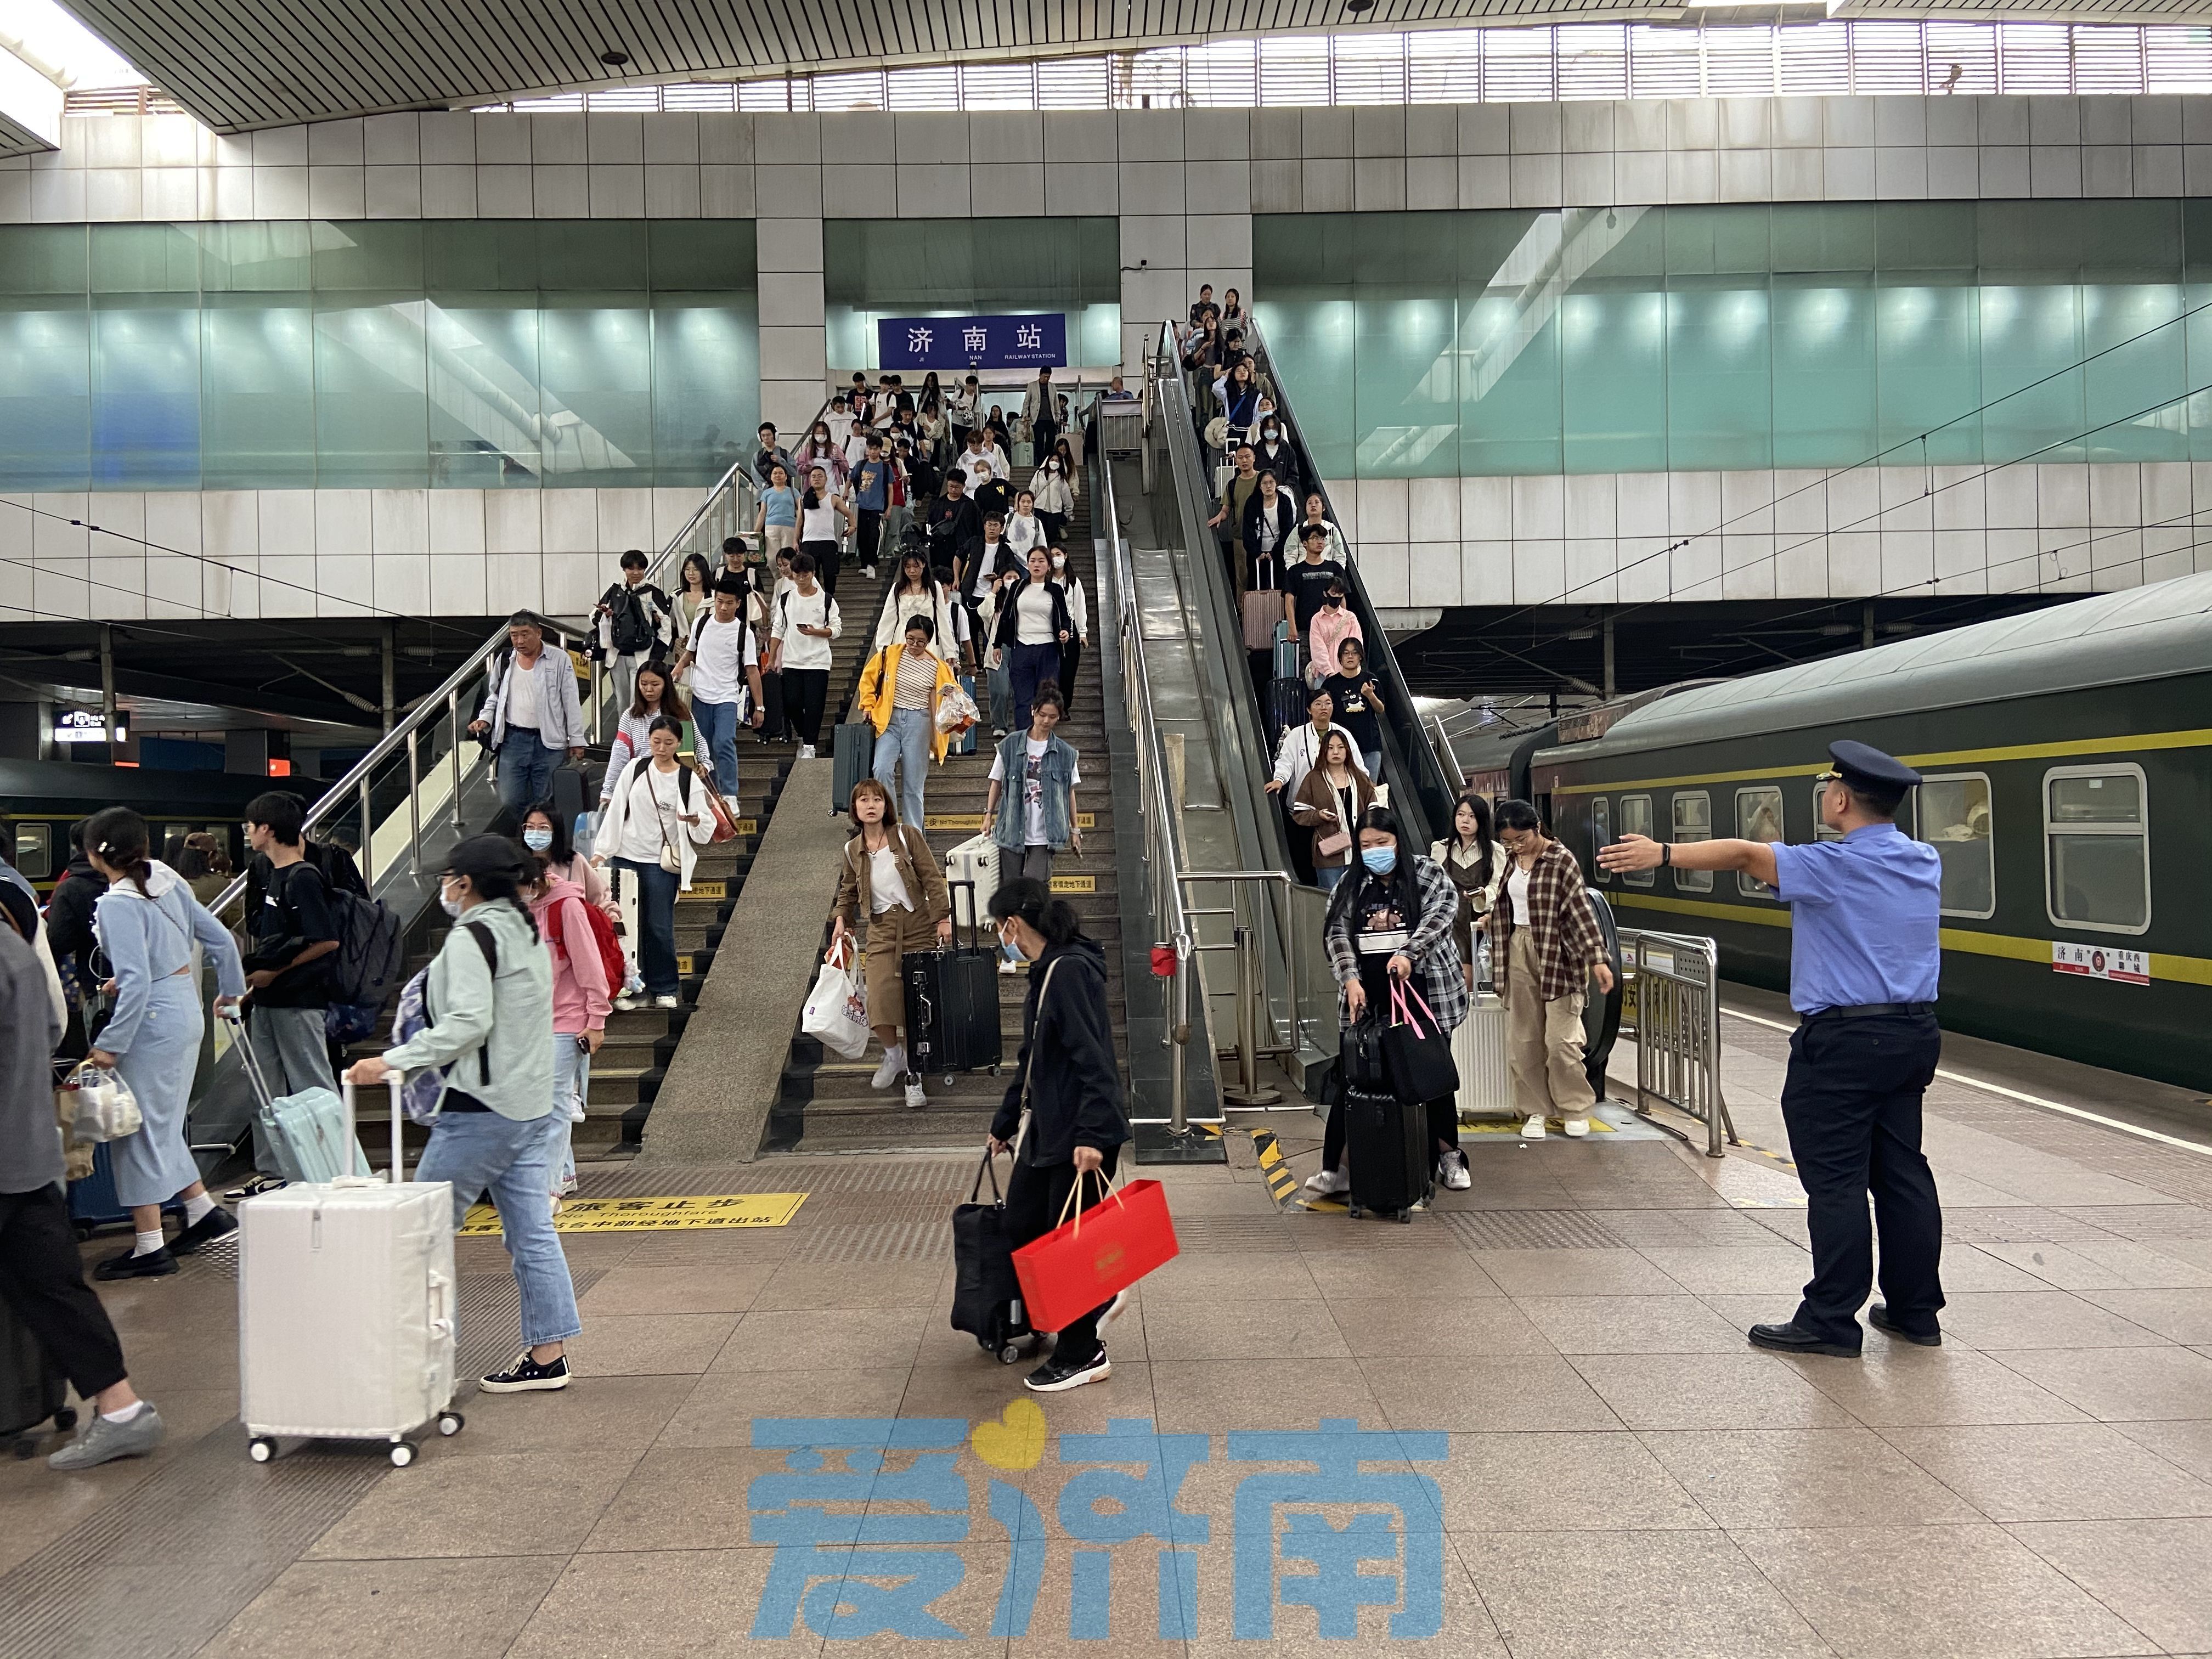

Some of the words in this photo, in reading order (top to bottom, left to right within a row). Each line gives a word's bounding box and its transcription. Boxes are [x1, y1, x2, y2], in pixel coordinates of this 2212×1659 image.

[907, 324, 1042, 353] 济南站
[2057, 946, 2083, 962] 济南
[564, 1198, 746, 1212] 旅客止步
